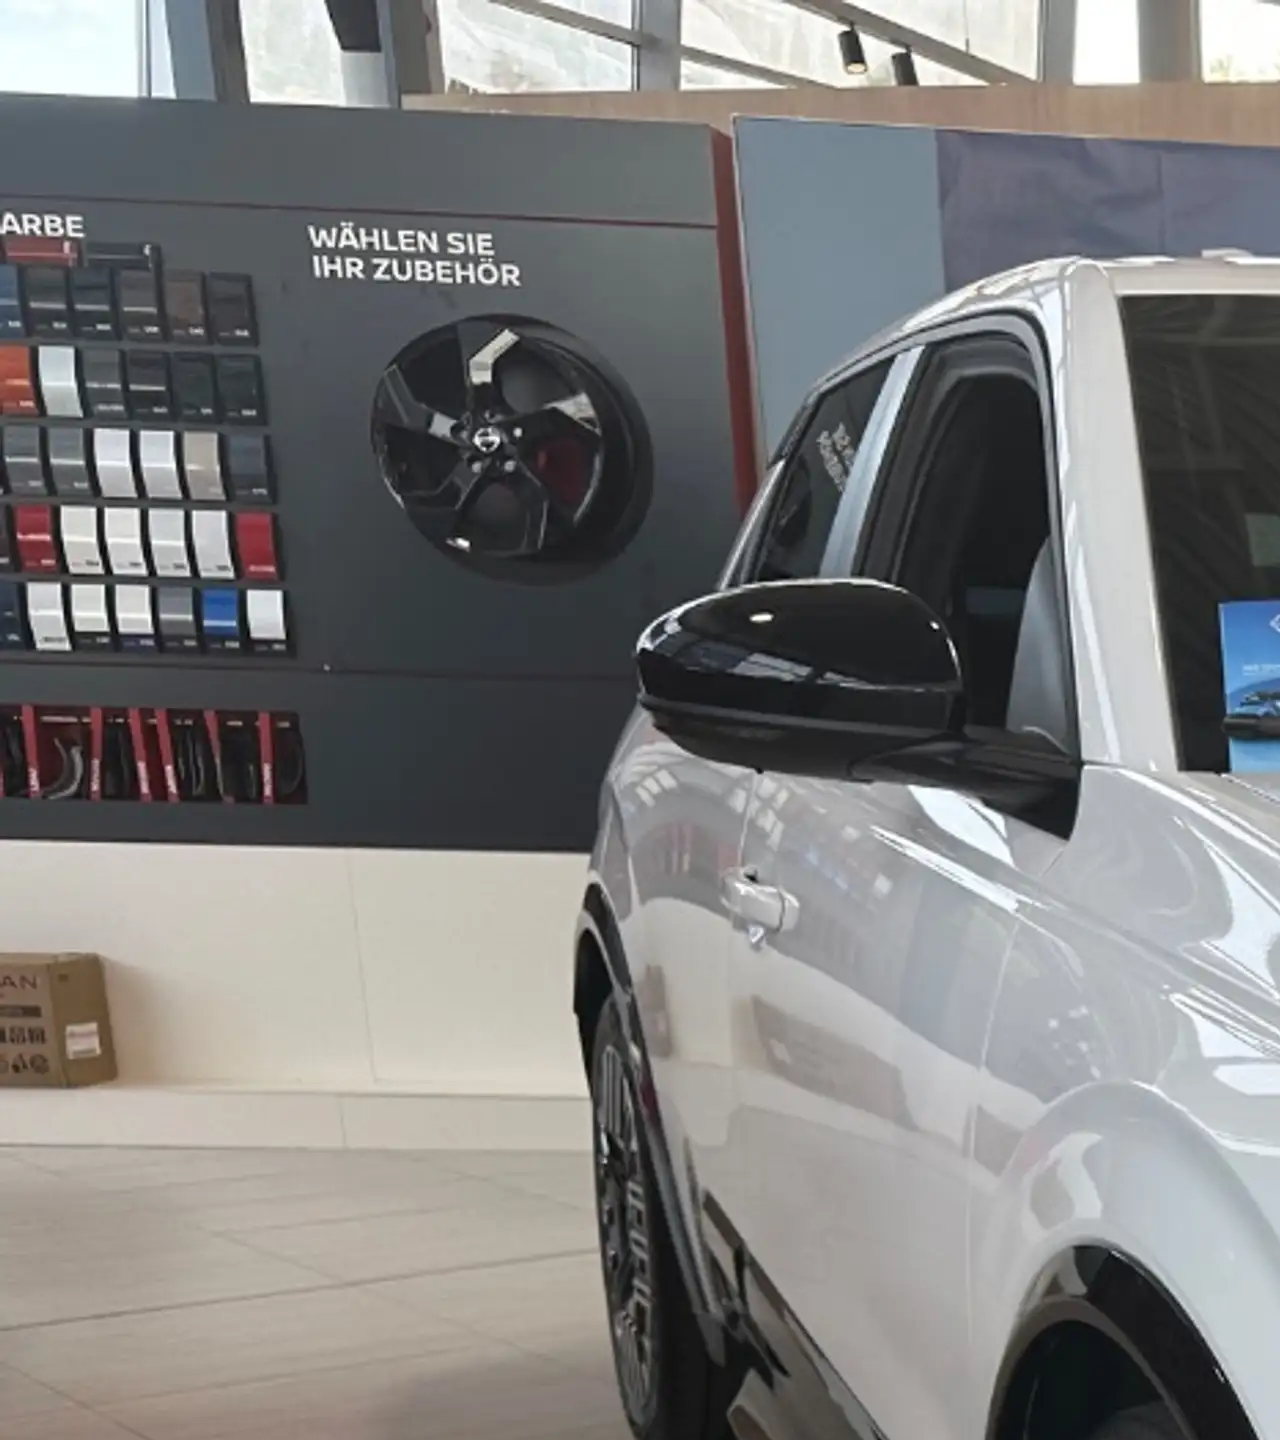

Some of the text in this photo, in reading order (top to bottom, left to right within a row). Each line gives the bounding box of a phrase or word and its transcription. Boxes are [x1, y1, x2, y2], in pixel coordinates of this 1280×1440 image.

[0, 212, 85, 238] ARBE
[308, 222, 495, 256] WÄHLEN SIE
[312, 255, 522, 286] IHR ZUBEHÖR
